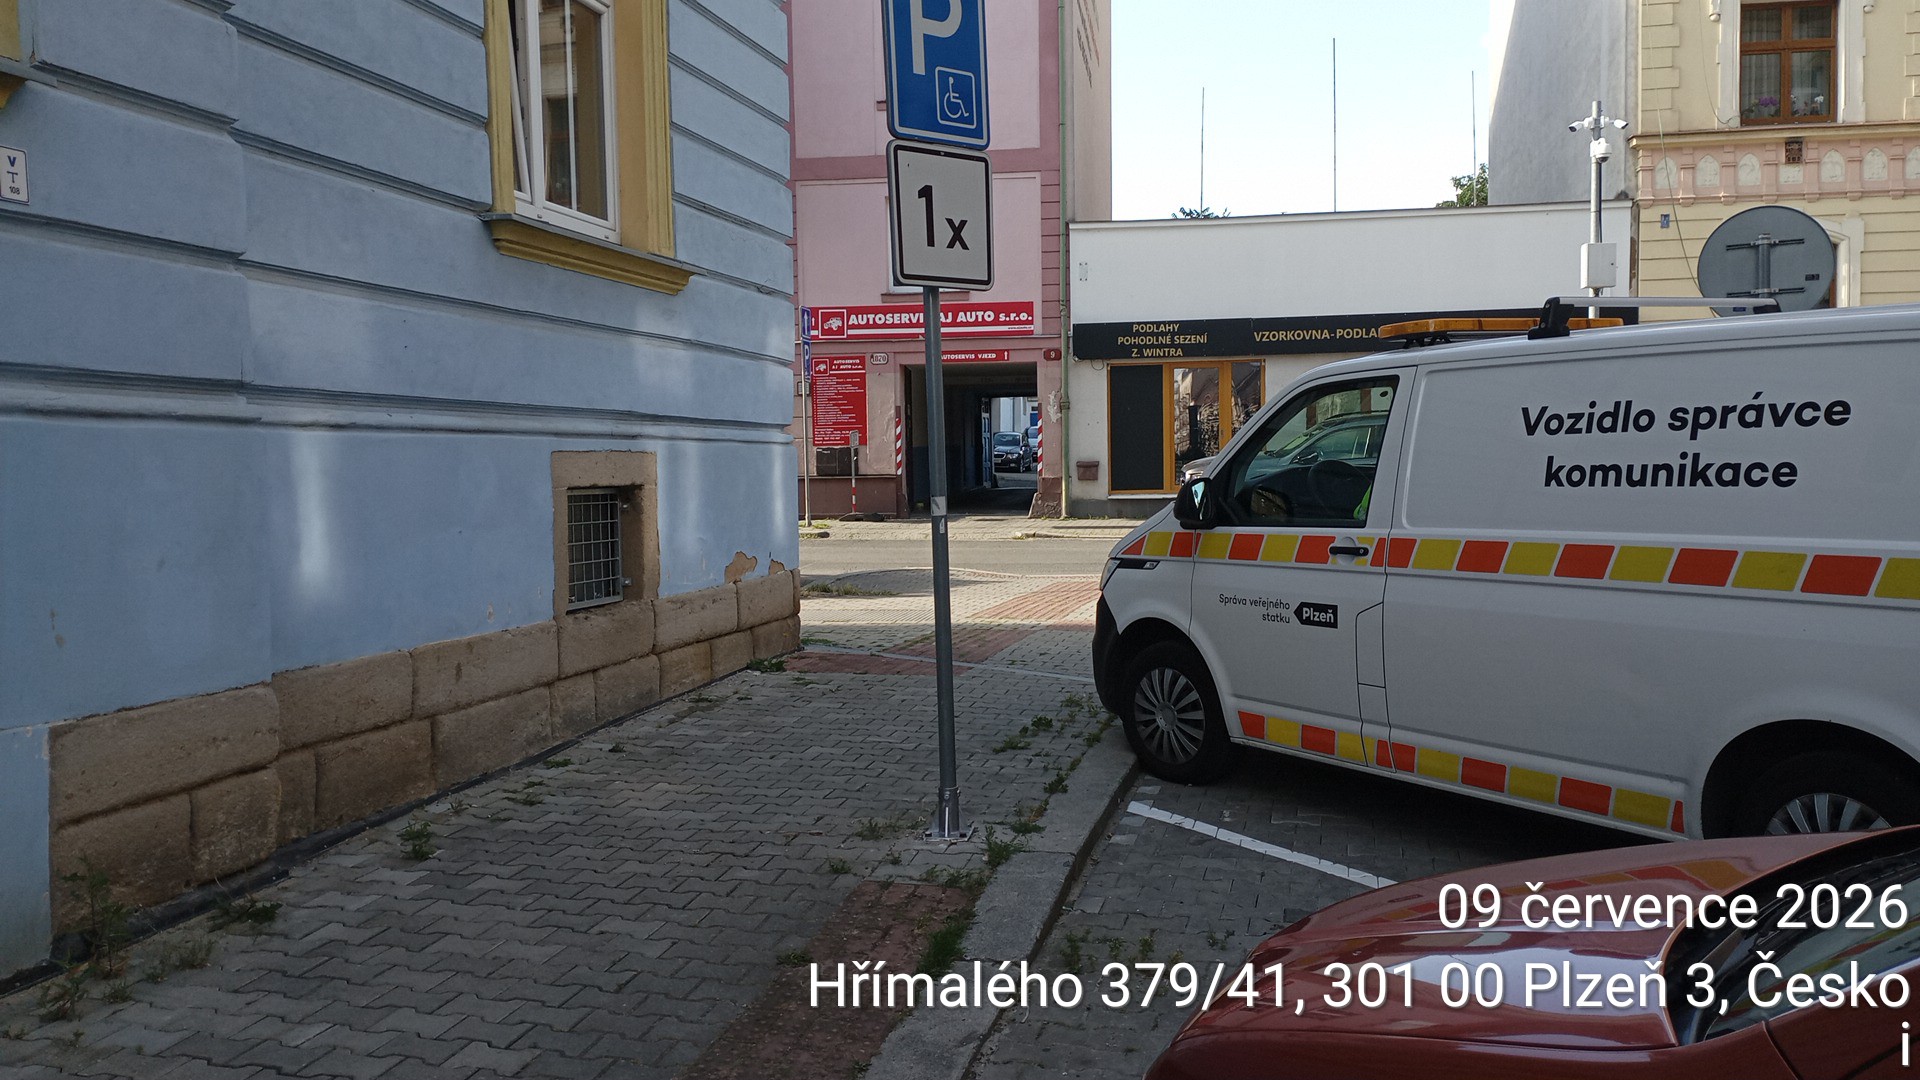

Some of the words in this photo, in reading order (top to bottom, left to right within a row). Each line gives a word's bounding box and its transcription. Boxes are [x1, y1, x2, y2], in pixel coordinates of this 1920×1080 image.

[910, 0, 963, 75] P
[7, 155, 17, 167] V
[7, 171, 18, 183] T
[848, 312, 924, 325] AUTOSERVI
[957, 311, 995, 322] AUTO
[999, 312, 1033, 321] s.r.o.
[1132, 323, 1180, 333] PODLAHY
[1253, 327, 1377, 342] VZORKOVNA-PODLA
[1117, 333, 1172, 345] POHODLNÉ
[1174, 332, 1208, 344] SEZENÍ
[1131, 348, 1141, 357] Z.
[1143, 348, 1183, 357] WINTRA
[1521, 400, 1656, 436] Vozidlo
[1667, 391, 1852, 440] správce
[1544, 451, 1798, 488] komunikace
[1219, 593, 1247, 606] Správa
[1249, 597, 1290, 611] veřejného
[1262, 612, 1290, 624] statku
[1302, 607, 1334, 623] Plzeň
